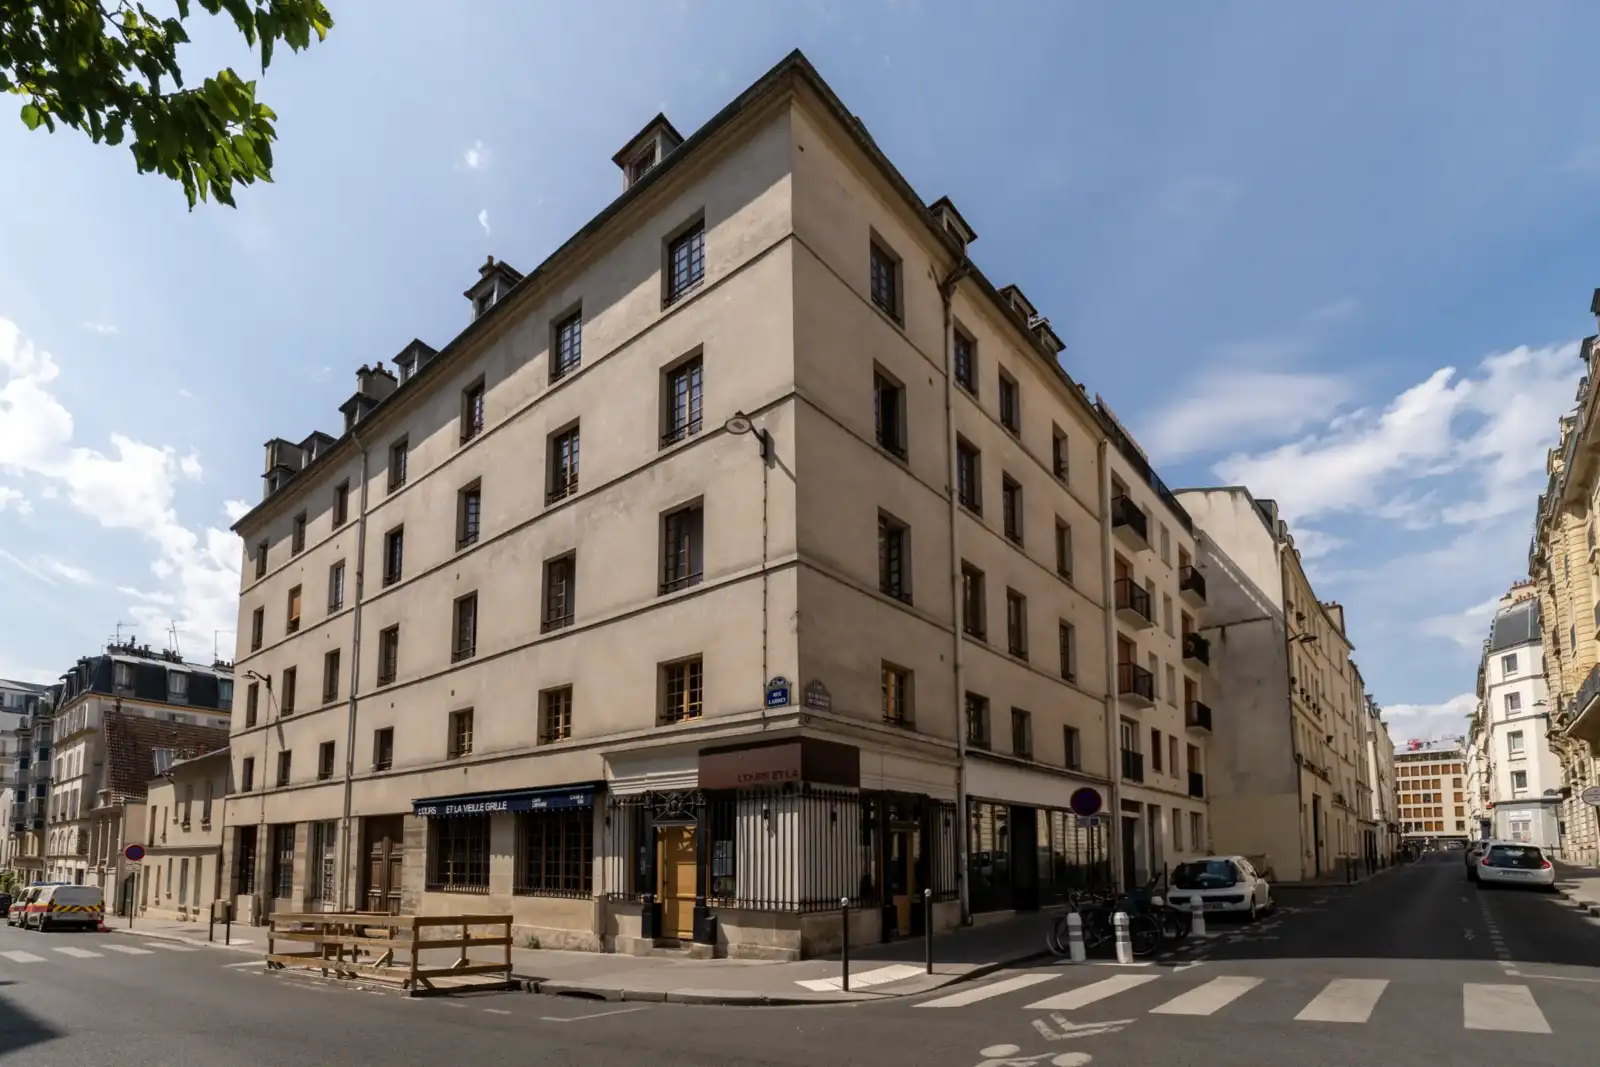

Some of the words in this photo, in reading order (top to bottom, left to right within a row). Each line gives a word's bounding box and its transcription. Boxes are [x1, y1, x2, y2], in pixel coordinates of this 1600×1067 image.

[772, 770, 783, 780] ET
[786, 770, 798, 778] LA
[485, 801, 507, 811] GRILLE
